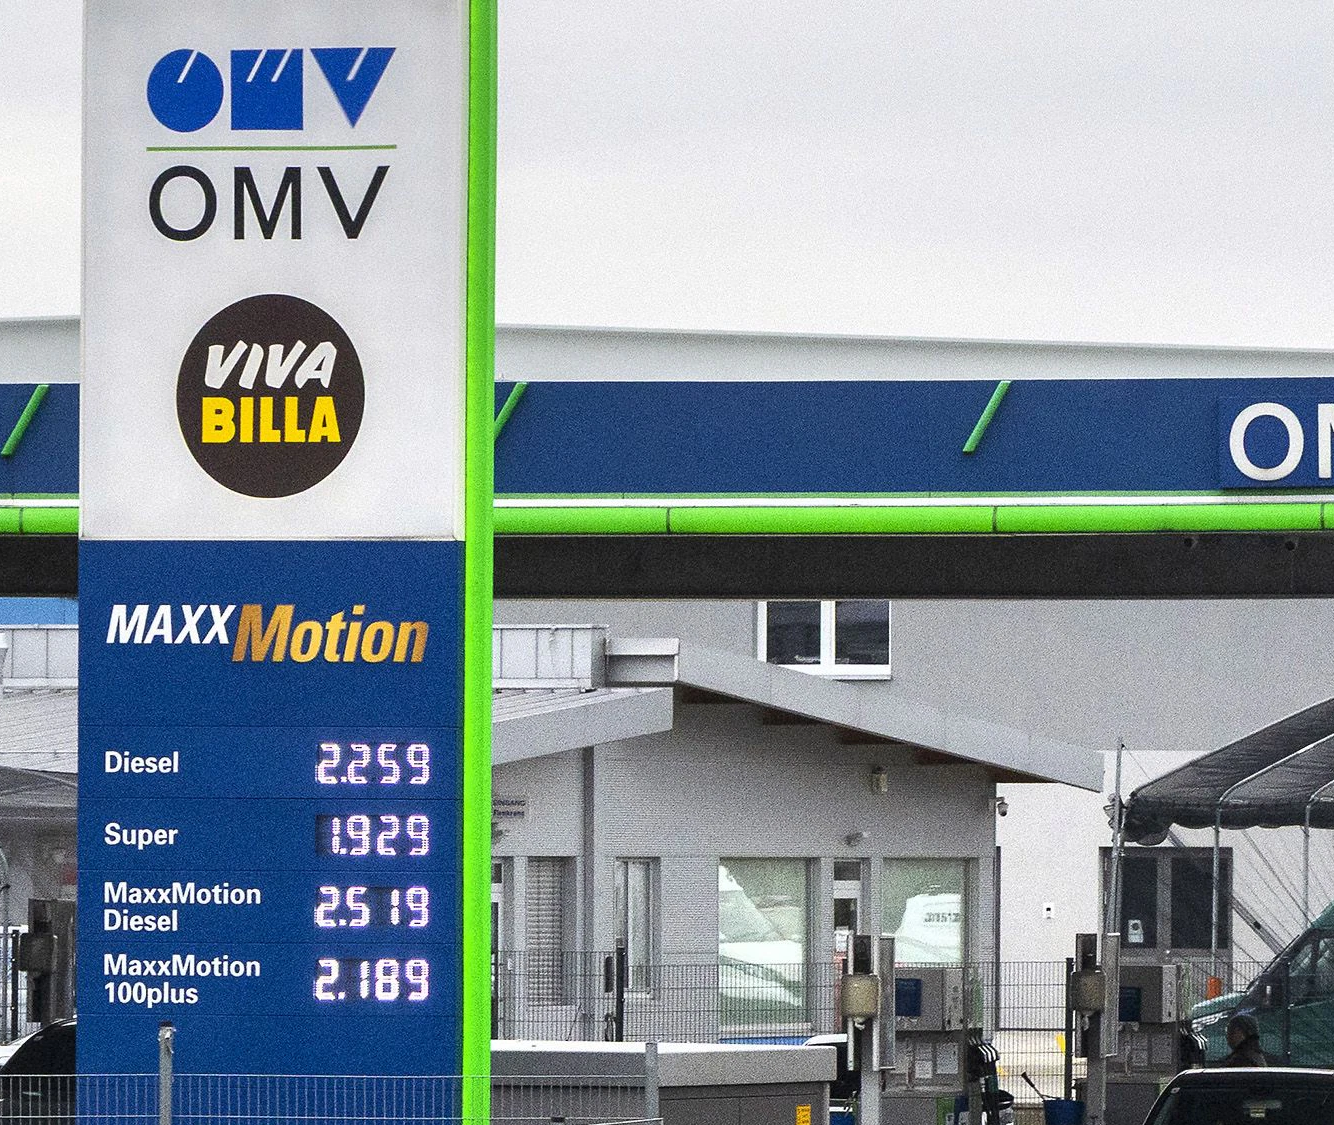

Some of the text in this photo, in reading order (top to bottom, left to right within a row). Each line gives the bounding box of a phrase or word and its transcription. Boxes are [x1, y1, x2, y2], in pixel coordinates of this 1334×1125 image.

[148, 165, 391, 242] OMV
[204, 340, 338, 390] VIVA
[201, 396, 341, 443] BILLA
[104, 742, 431, 785] Diesel 2.259
[104, 815, 431, 857] Super 1.929
[104, 881, 430, 929] MaxxMotion 2.519
[104, 908, 179, 932] Diesel
[104, 953, 430, 1001] MaxxMotion 2.189
[104, 981, 199, 1007] 100plus
